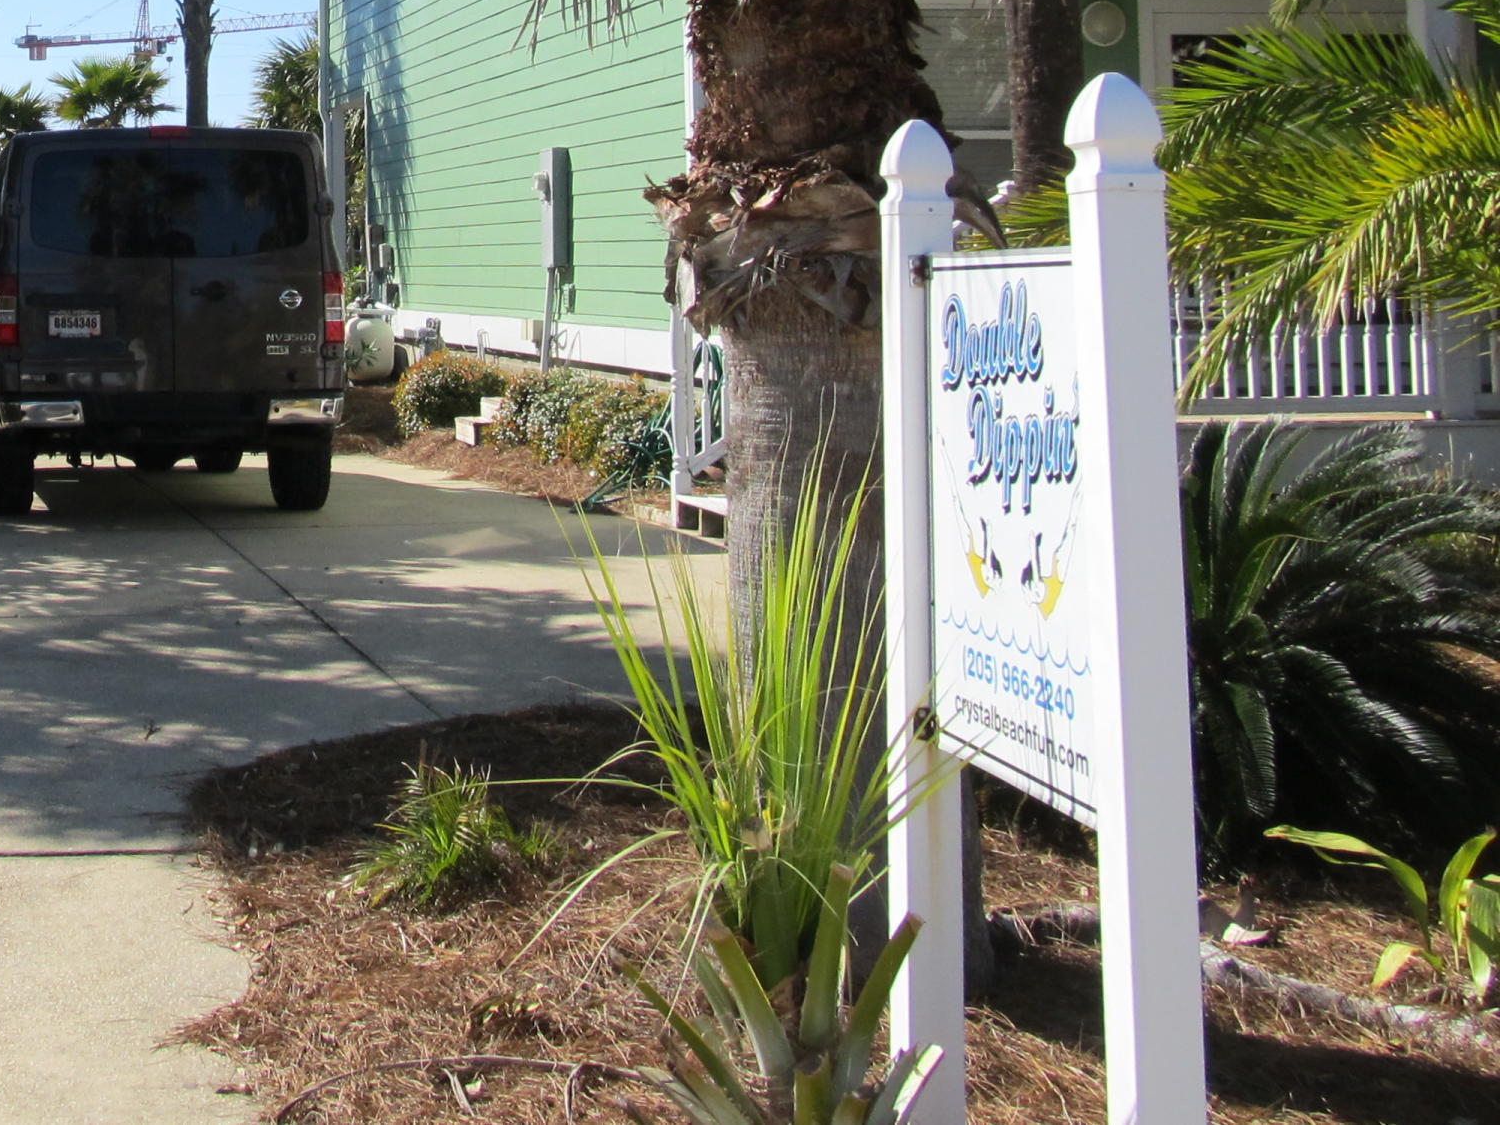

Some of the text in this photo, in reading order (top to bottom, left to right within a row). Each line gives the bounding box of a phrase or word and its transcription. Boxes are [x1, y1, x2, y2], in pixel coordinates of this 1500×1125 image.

[941, 277, 1043, 391] Double
[962, 644, 1075, 720] (205) 966-2240
[954, 694, 1090, 776] crystalbeachfun.com
